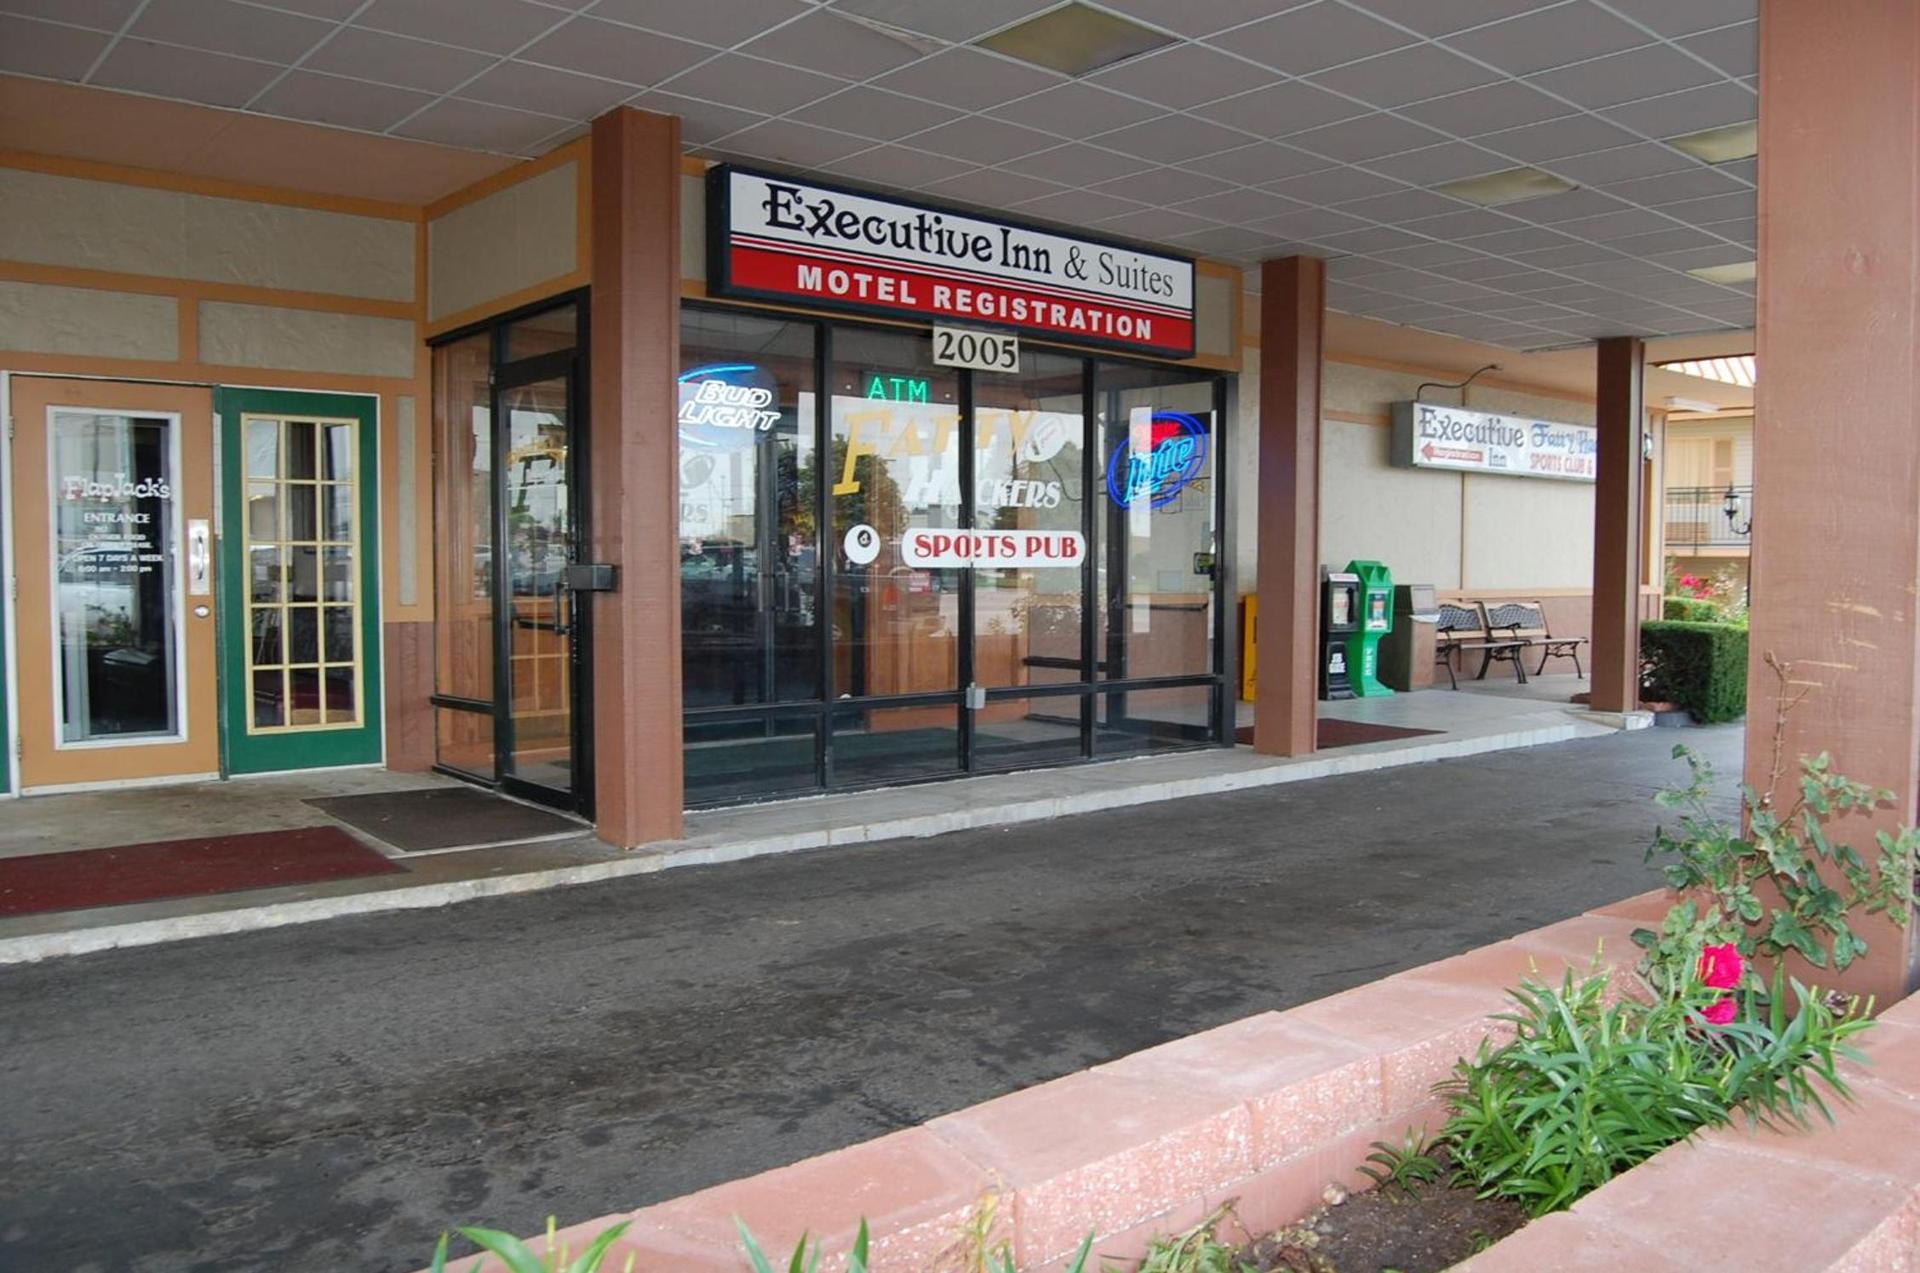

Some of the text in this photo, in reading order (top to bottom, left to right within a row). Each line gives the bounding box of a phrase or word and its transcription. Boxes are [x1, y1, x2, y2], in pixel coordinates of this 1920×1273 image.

[761, 182, 1174, 297] Executive Inn & Suites
[797, 264, 1152, 340] MOTEL REGISTRATION
[938, 331, 1016, 368] 2005
[694, 379, 773, 409] BUD
[868, 375, 927, 406] ATM
[678, 400, 782, 431] LIGHT
[1419, 408, 1525, 448] Executive
[832, 409, 1039, 496] FATTY
[1488, 447, 1508, 468] Inn
[1530, 452, 1561, 472] SPORTS
[84, 512, 151, 524] ENTRANCE
[914, 534, 1078, 559] SPORTS PUB
